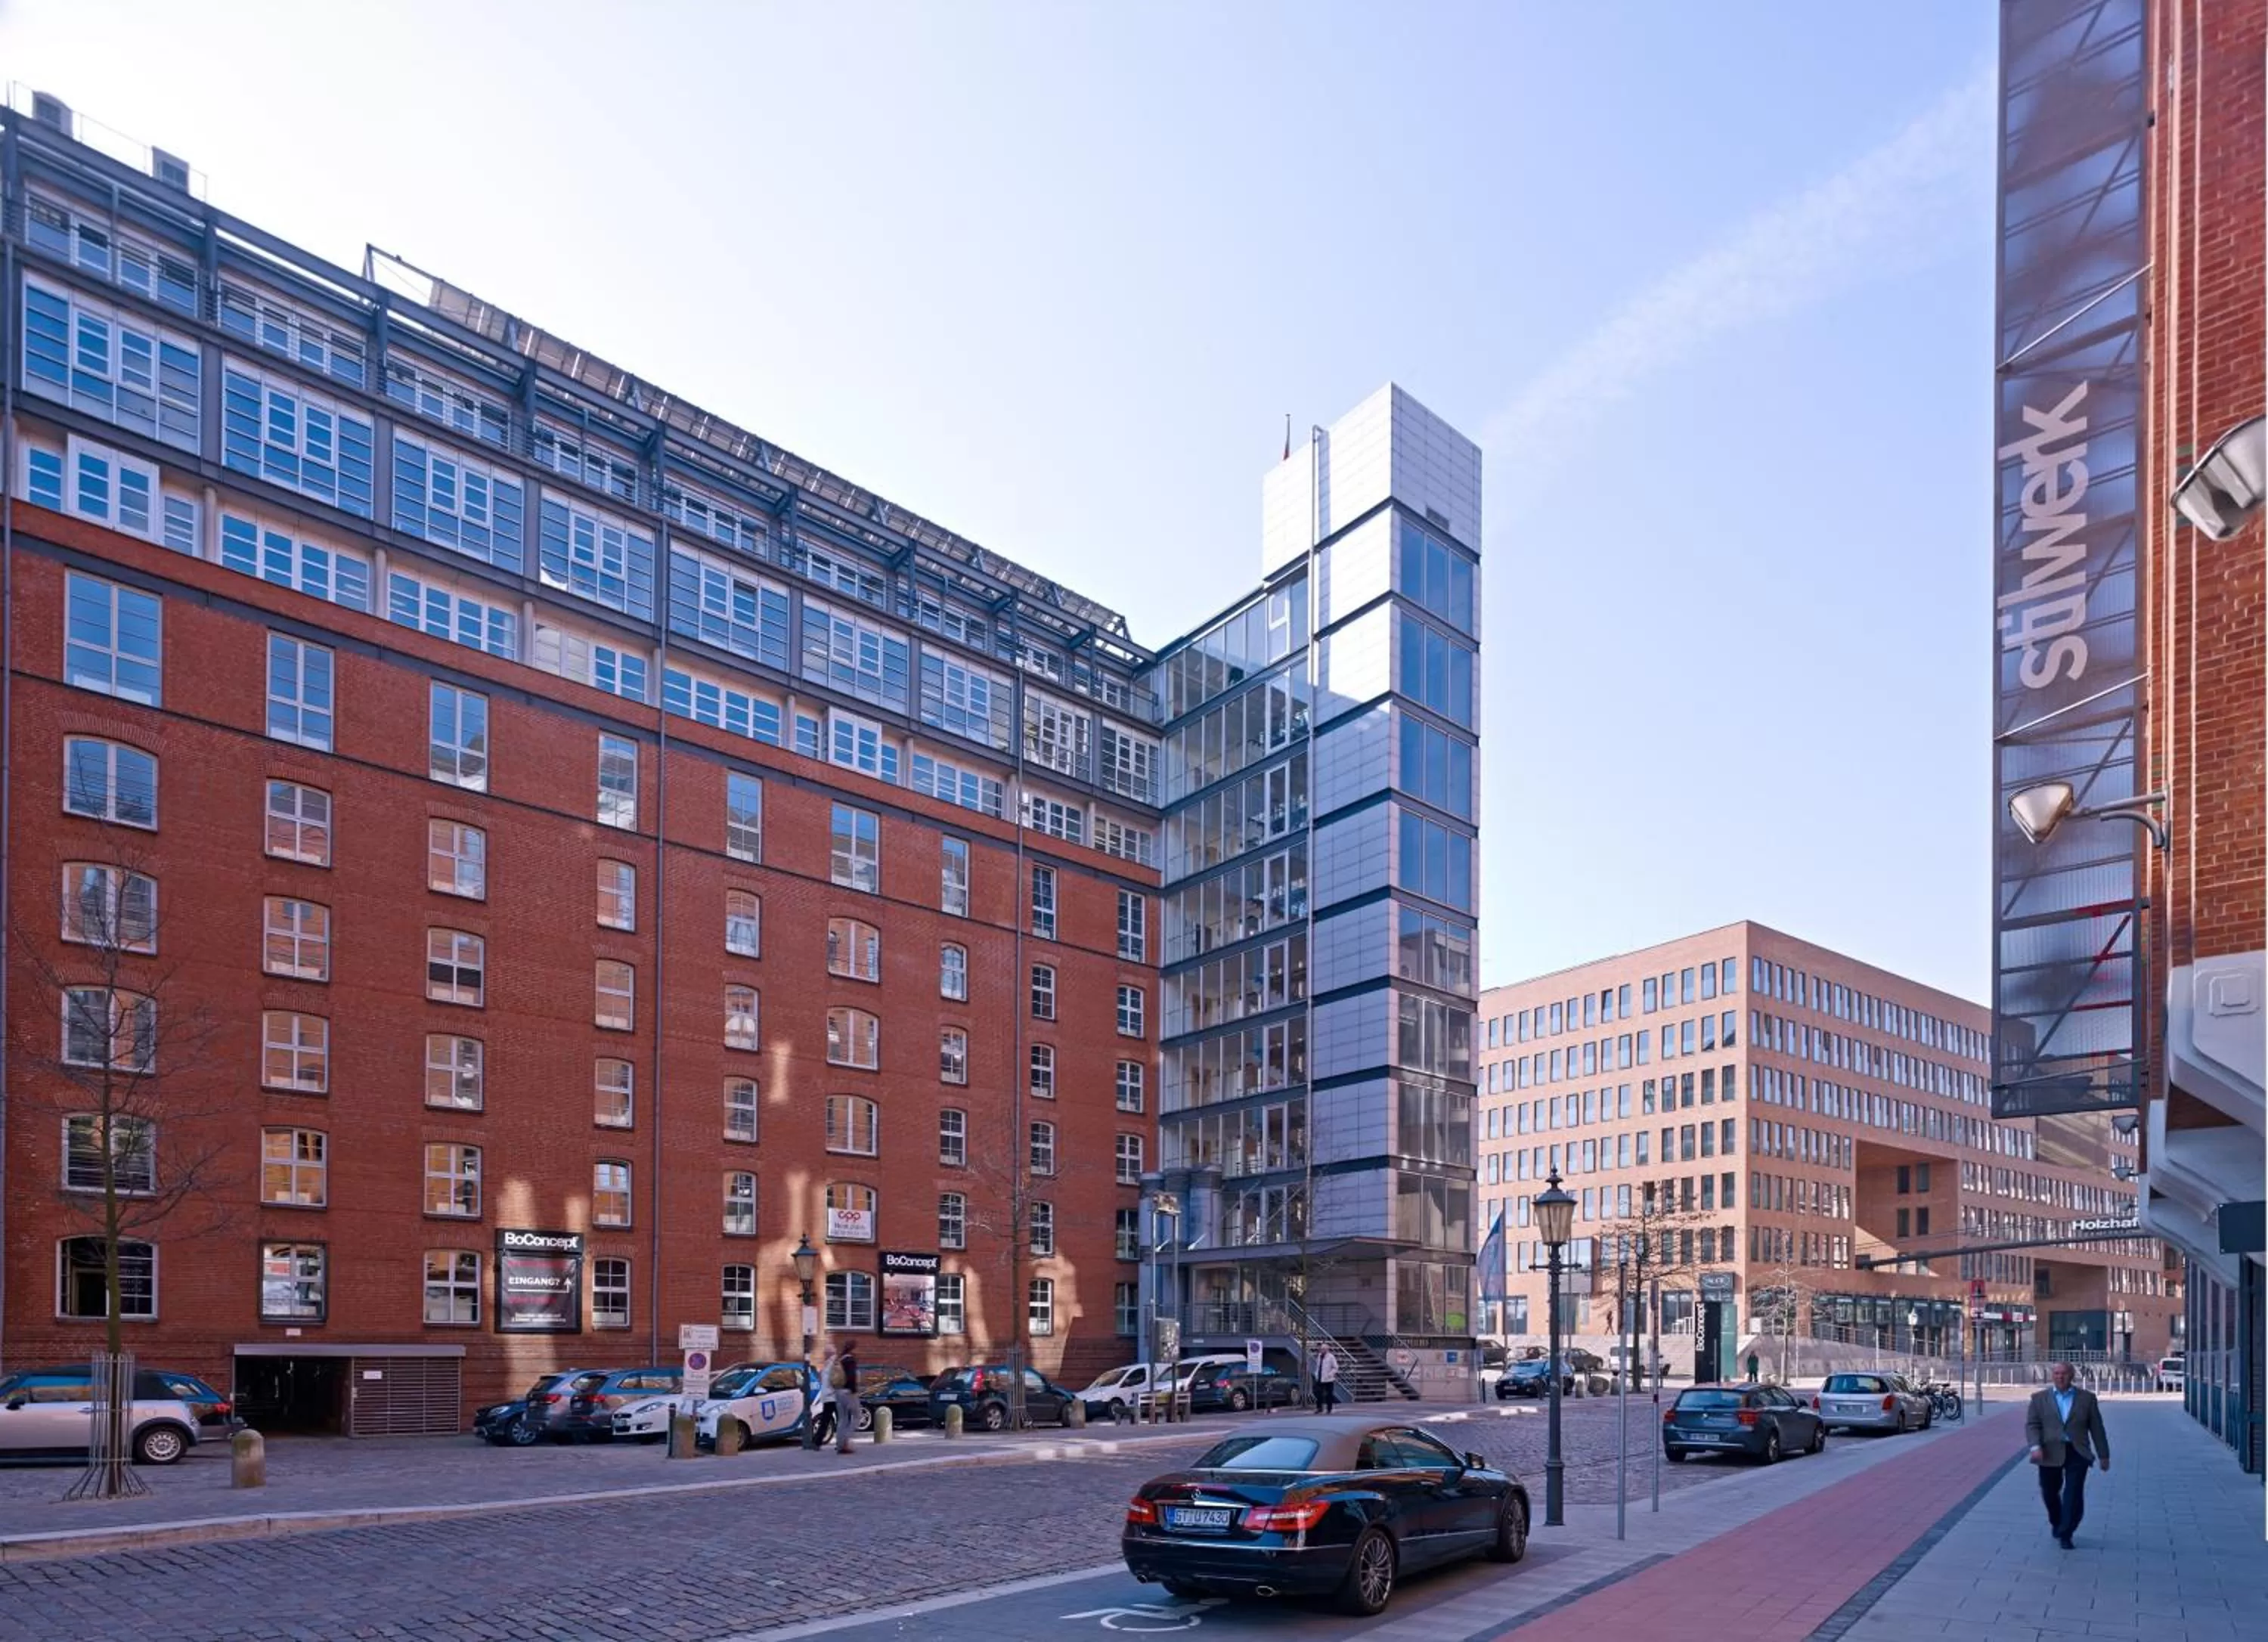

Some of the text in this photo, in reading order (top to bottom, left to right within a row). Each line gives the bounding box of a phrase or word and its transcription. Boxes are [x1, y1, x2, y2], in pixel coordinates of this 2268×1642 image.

[1997, 380, 2088, 689] stilwerk
[504, 1232, 579, 1250] BoConcept
[886, 1254, 937, 1269] BoConcept
[508, 1276, 560, 1286] EINGANG?
[1696, 1303, 1707, 1352] BoConcept
